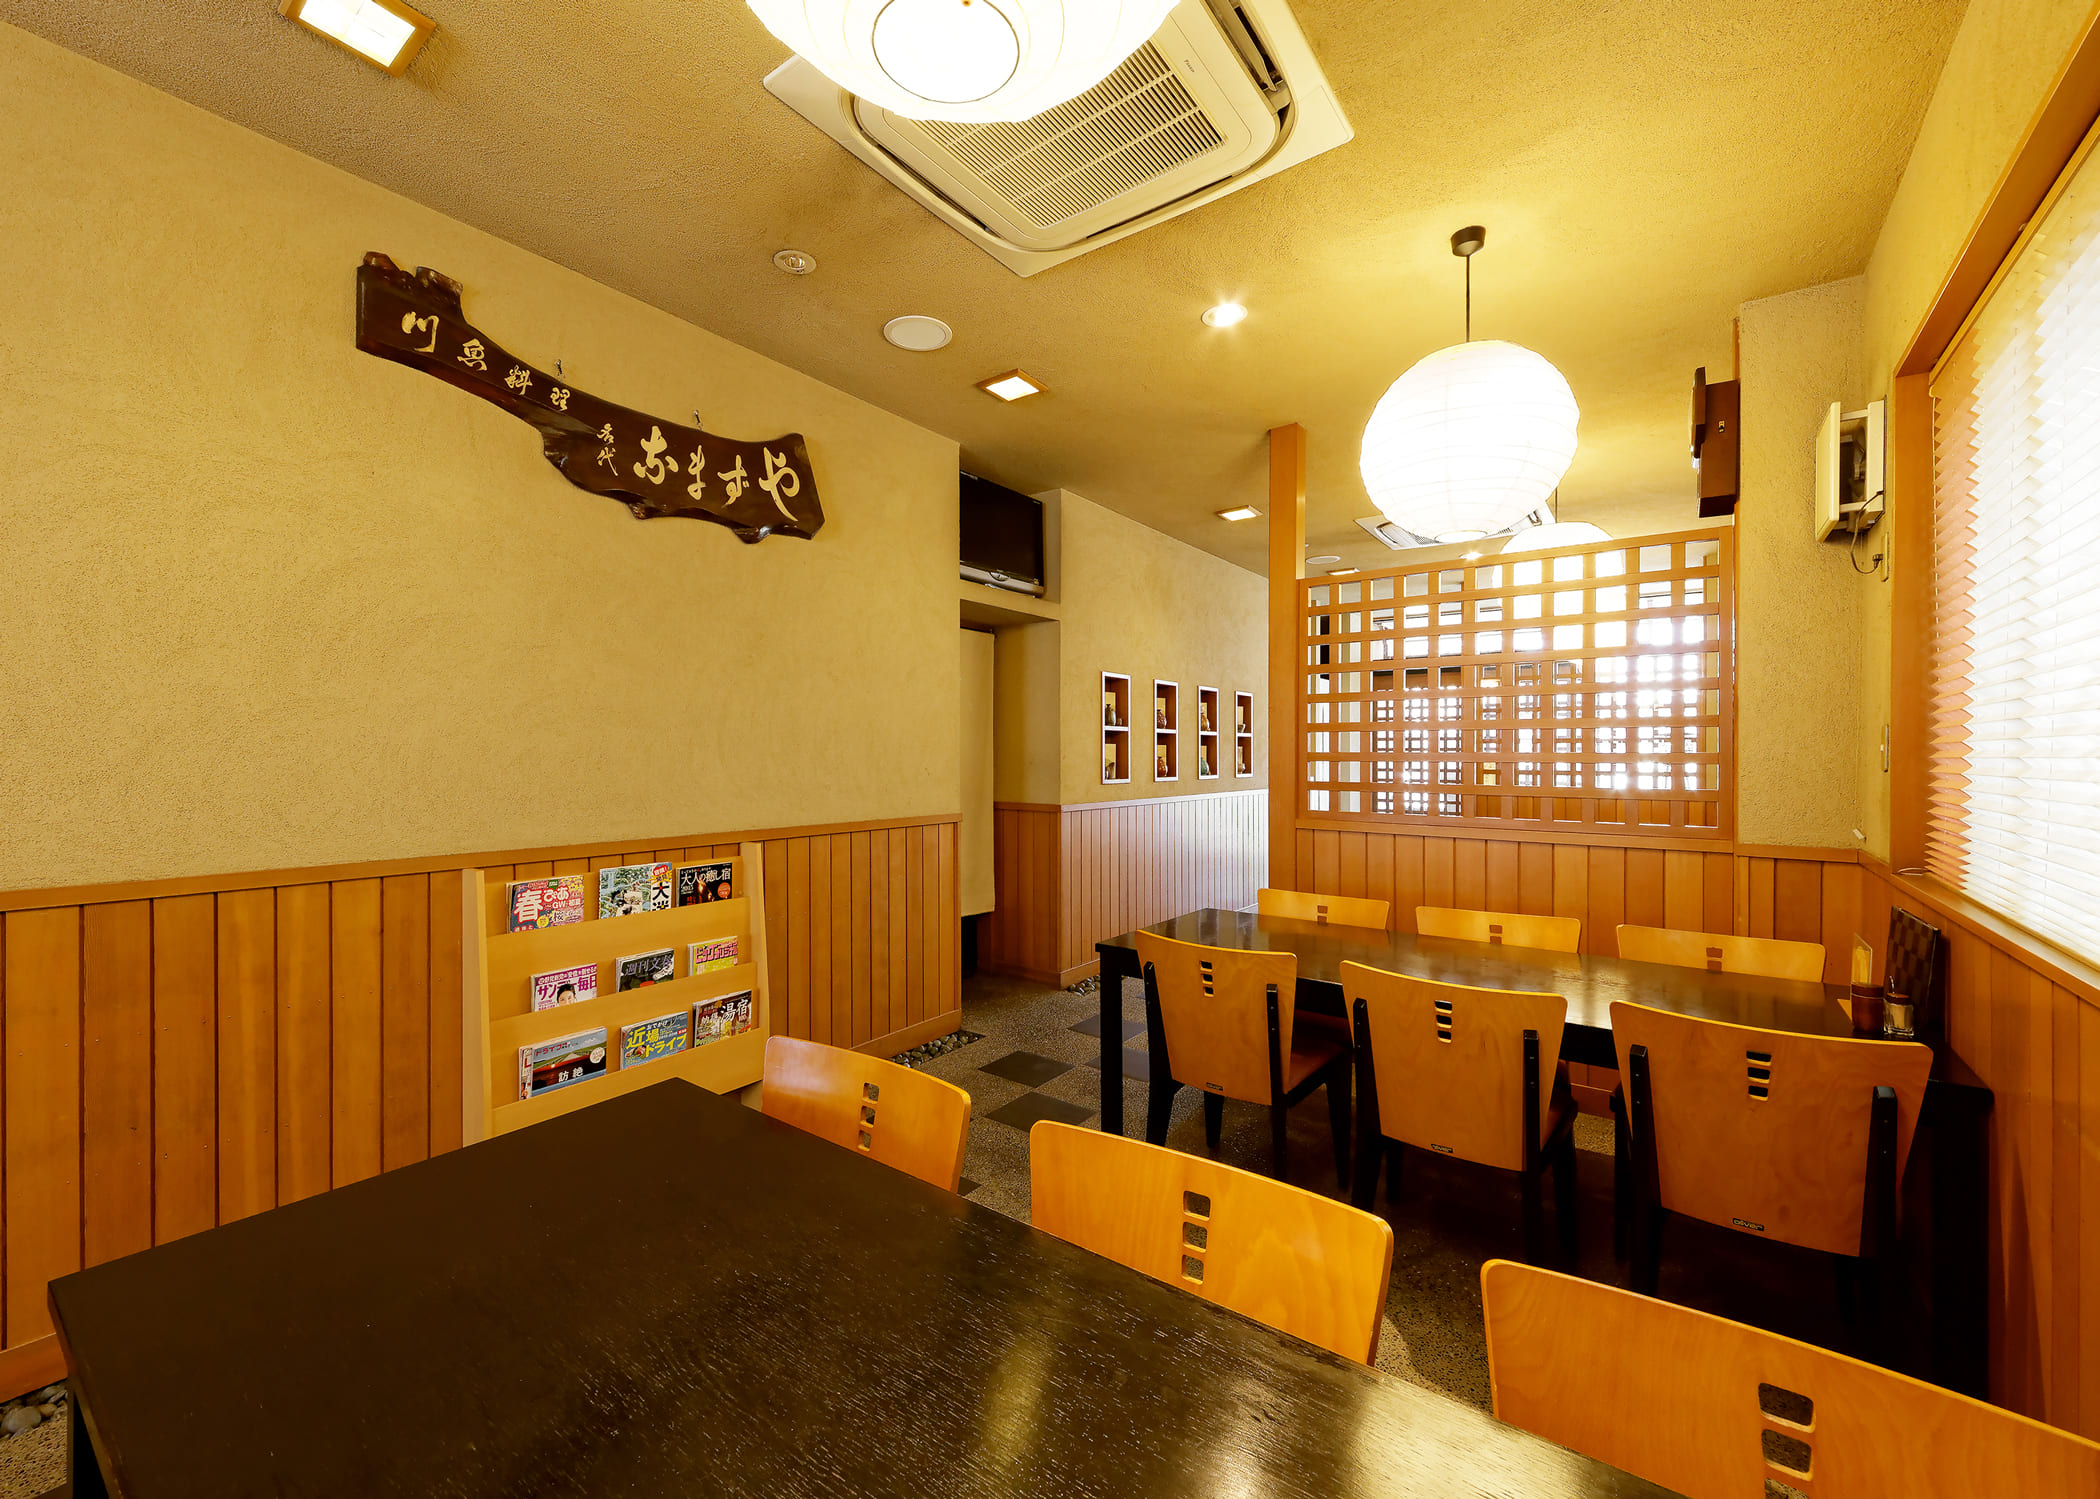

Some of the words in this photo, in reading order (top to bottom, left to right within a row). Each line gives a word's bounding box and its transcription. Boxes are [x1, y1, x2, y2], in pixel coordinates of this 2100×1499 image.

[401, 310, 571, 412] 川魚料理
[633, 425, 801, 522] なまずや
